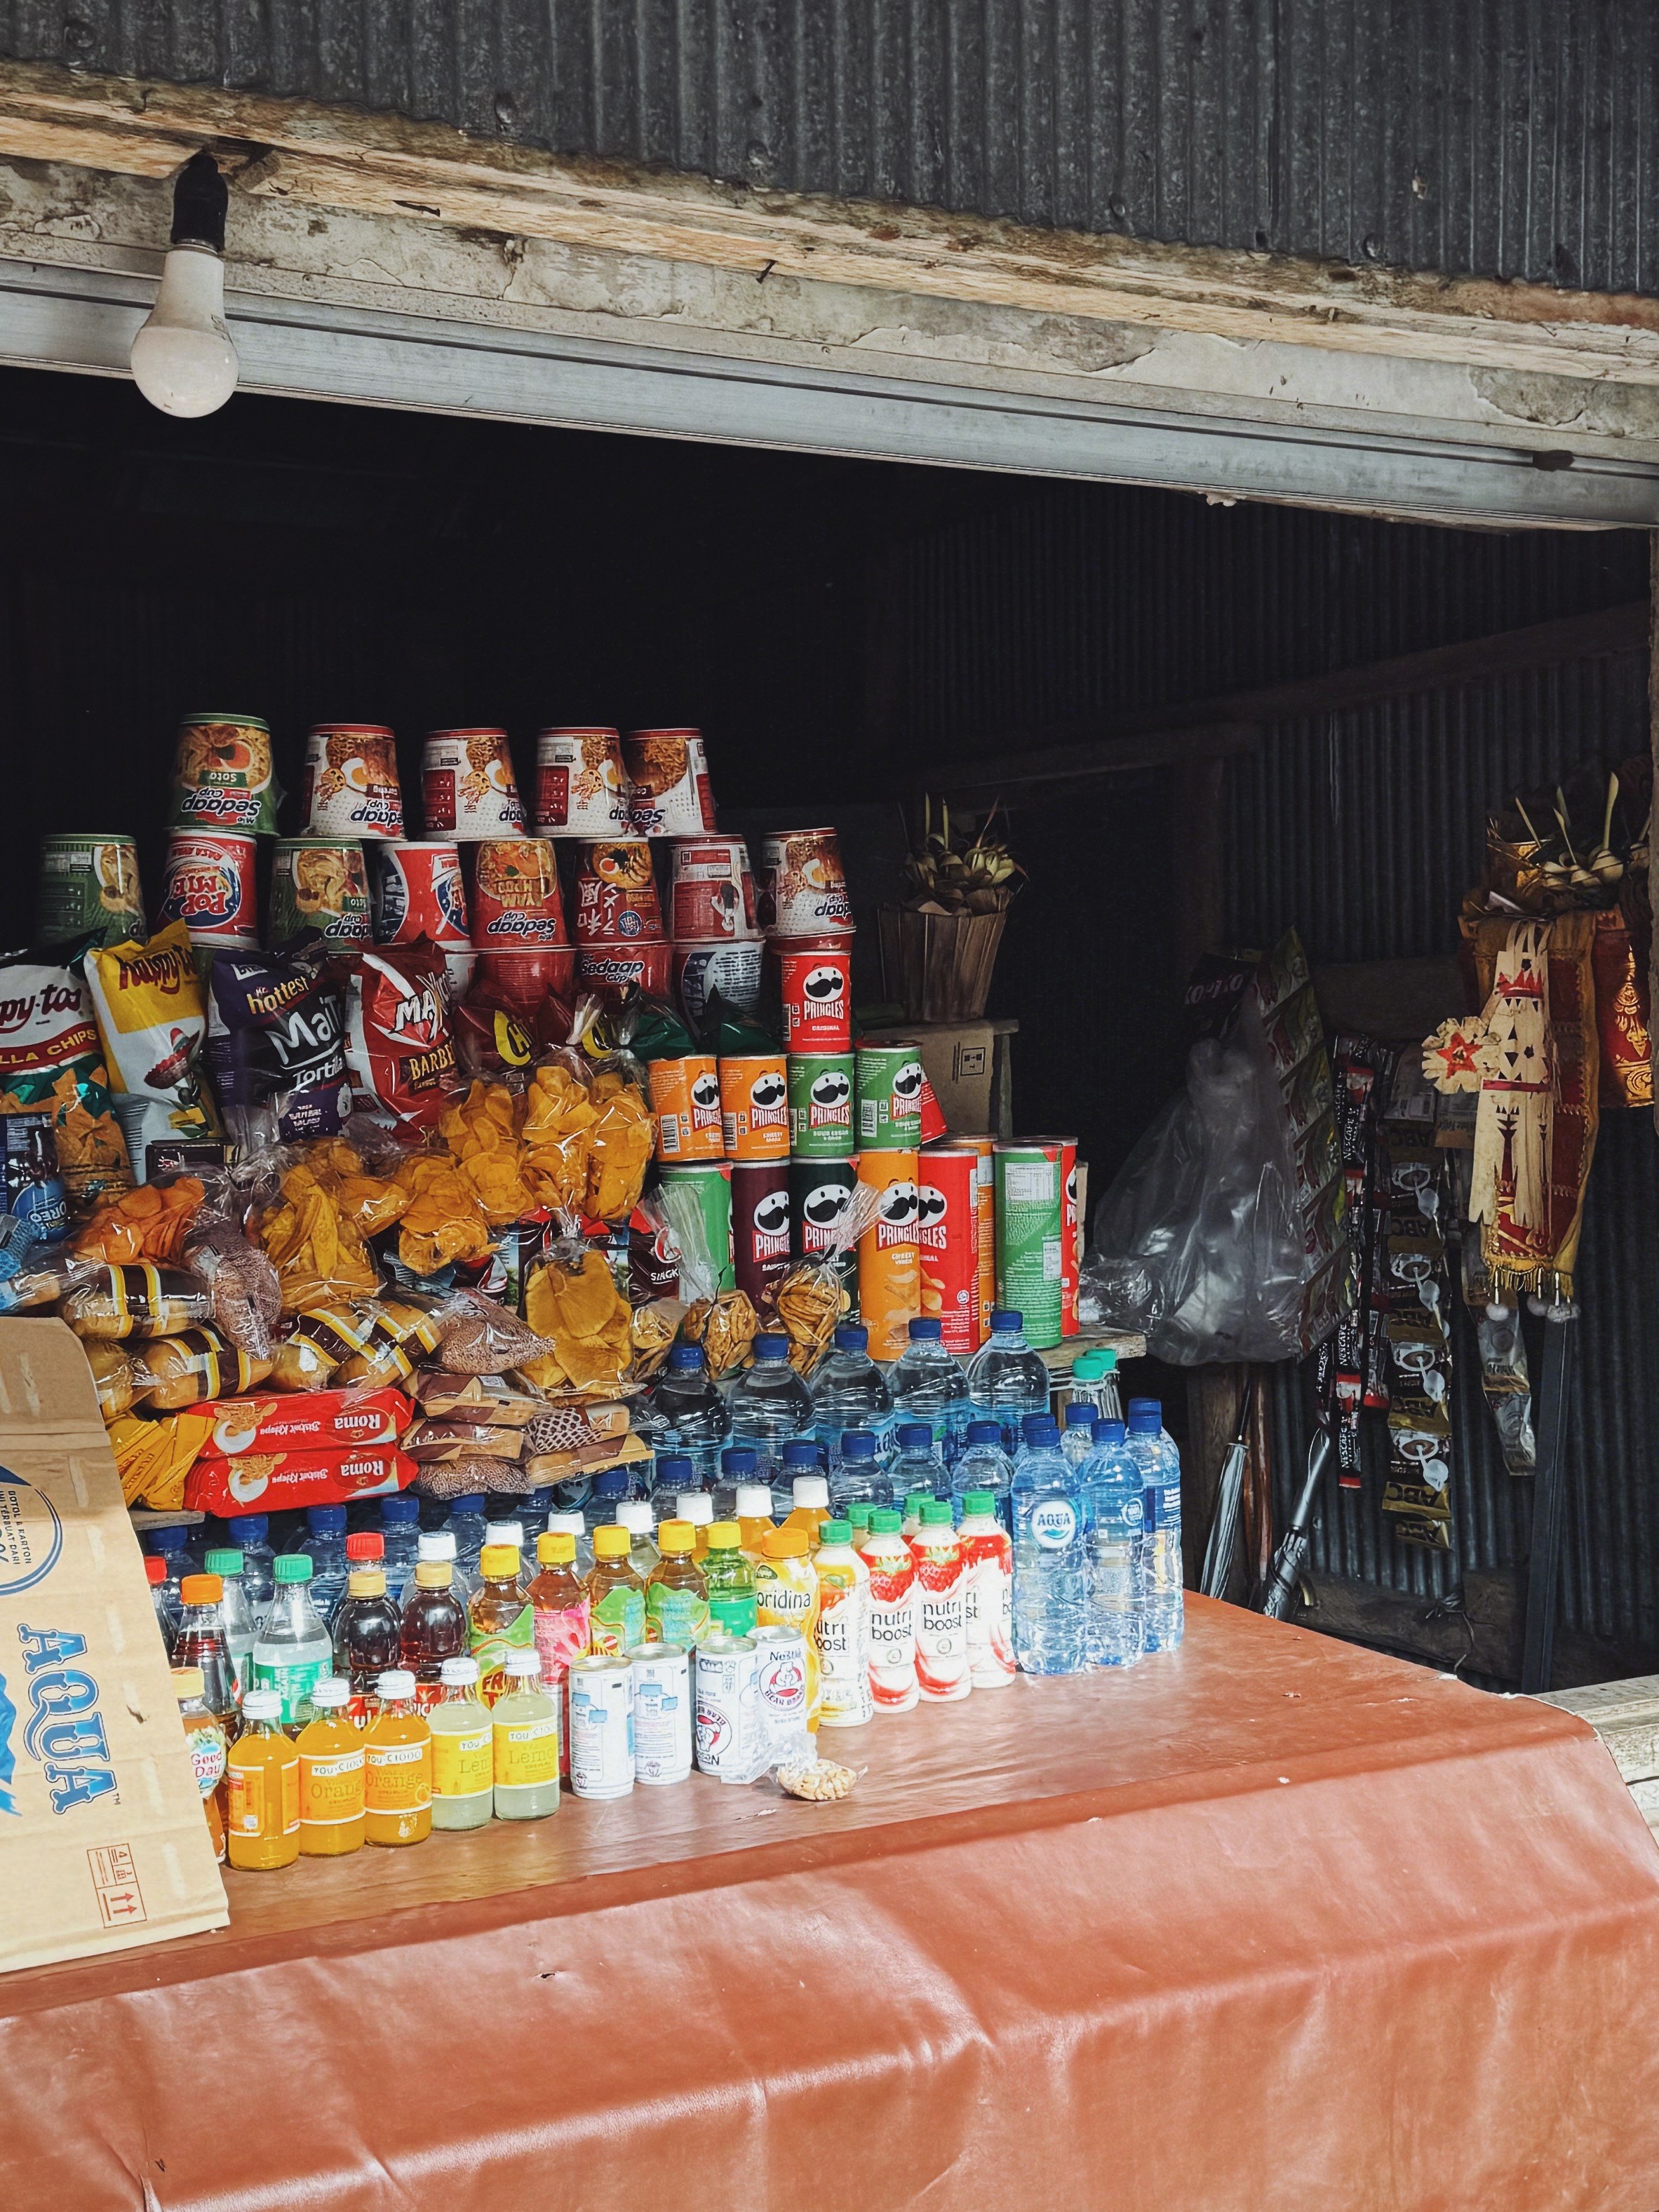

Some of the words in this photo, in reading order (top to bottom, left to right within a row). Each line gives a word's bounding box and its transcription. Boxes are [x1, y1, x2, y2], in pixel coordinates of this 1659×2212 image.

[210, 773, 237, 783] Soto
[181, 793, 261, 817] Sedaap
[172, 875, 218, 900] MIE
[180, 891, 228, 915] POP
[487, 918, 557, 940] Sedaap
[581, 958, 645, 977] Sedaap
[246, 975, 309, 1015] hottest
[803, 999, 845, 1021] PRINGLES
[46, 1028, 98, 1056] CHIPS
[810, 1105, 850, 1126] PRINGLES
[29, 1197, 67, 1223] OREO
[920, 1225, 947, 1249] GLES
[333, 1413, 381, 1430] Roma
[340, 1460, 384, 1477] Roma
[1387, 1481, 1442, 1508] ABC
[8, 1490, 22, 1518] BOTOL
[17, 1528, 32, 1565] KARTON
[1037, 1511, 1071, 1528] AQUA
[9, 1544, 20, 1565] DARI
[757, 1589, 812, 1610] oridina
[922, 1600, 962, 1616] nutri
[923, 1614, 962, 1631] boost
[871, 1626, 913, 1642] boost
[17, 1623, 117, 1815] AQUA
[191, 1751, 223, 1766] Good
